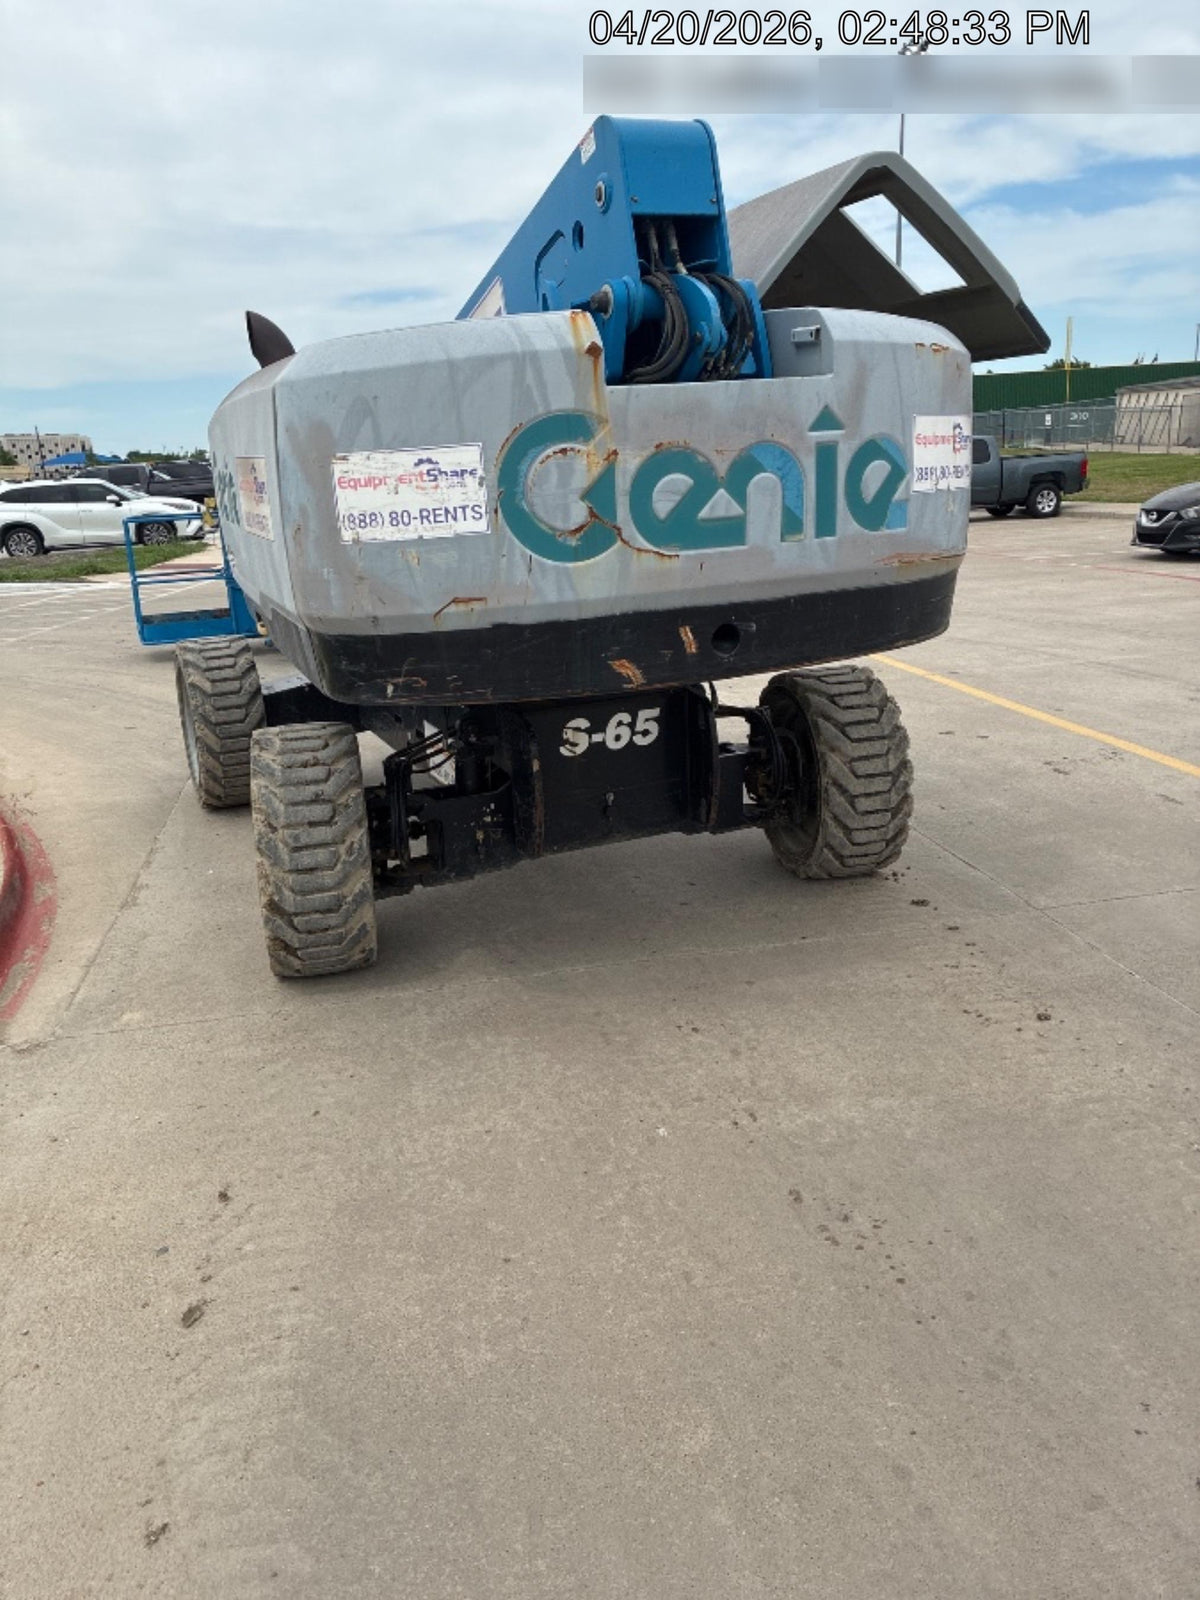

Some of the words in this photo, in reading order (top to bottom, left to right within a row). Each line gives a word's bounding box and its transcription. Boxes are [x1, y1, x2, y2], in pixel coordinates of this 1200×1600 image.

[497, 404, 909, 564] Genie
[342, 511, 385, 531] (888)
[389, 504, 483, 527] 80-RENTS
[559, 707, 661, 757] S-65
